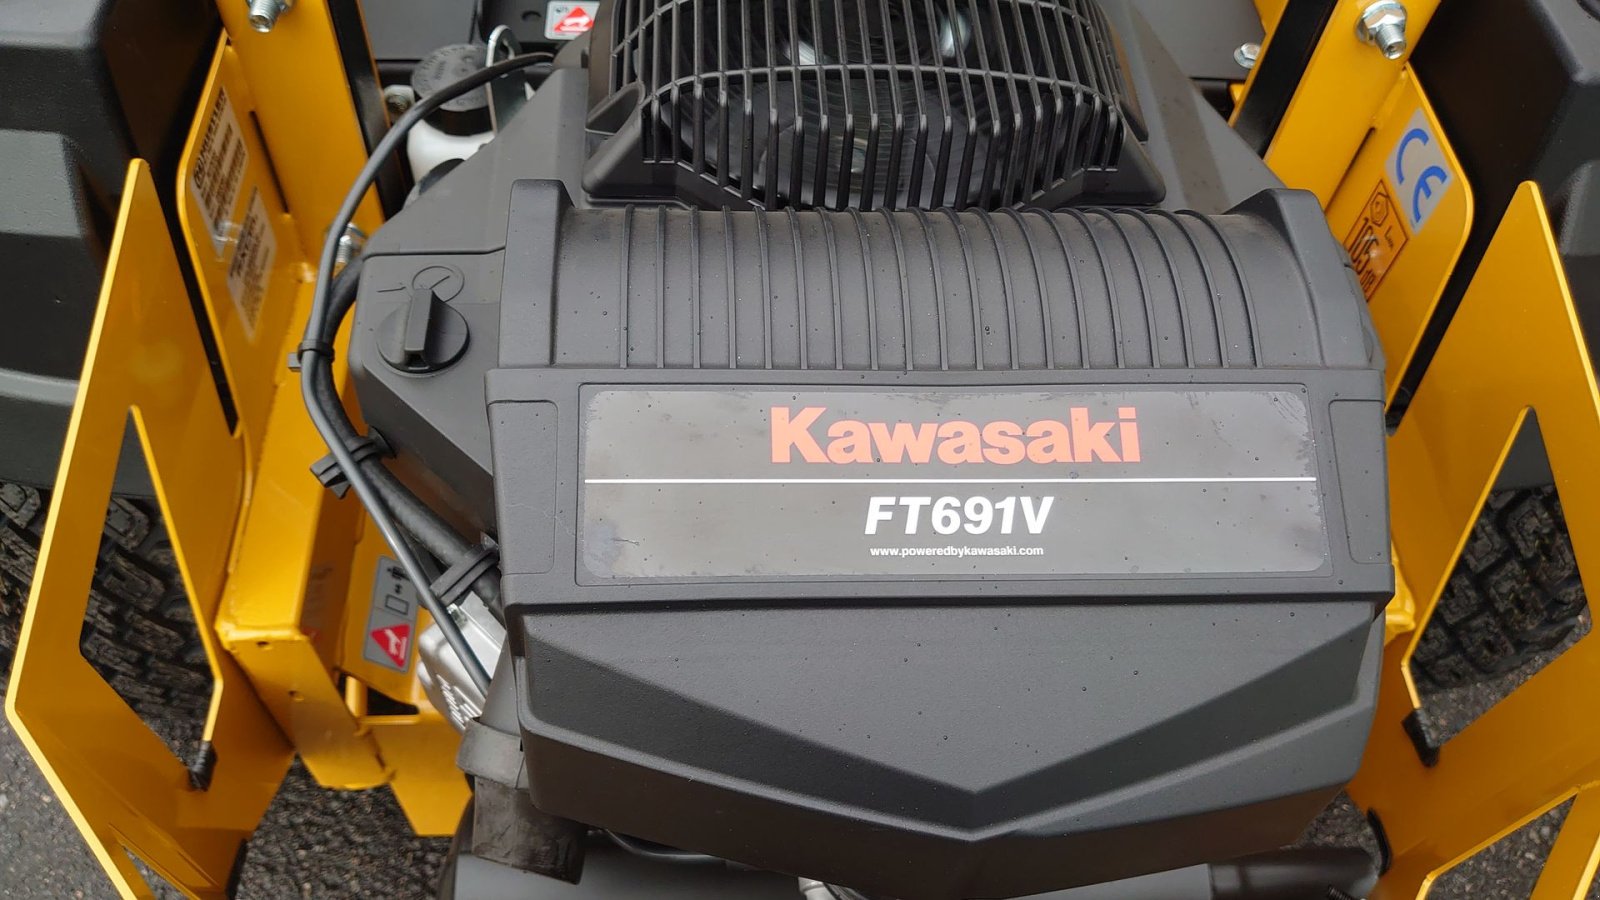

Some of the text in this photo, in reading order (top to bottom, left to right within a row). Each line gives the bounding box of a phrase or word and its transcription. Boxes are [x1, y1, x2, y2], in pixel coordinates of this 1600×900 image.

[1396, 128, 1447, 223] CE
[770, 406, 1140, 465] Kawasaki
[864, 496, 1055, 535] FT691V
[869, 545, 1044, 558] www.poweredbykawasaki.com
